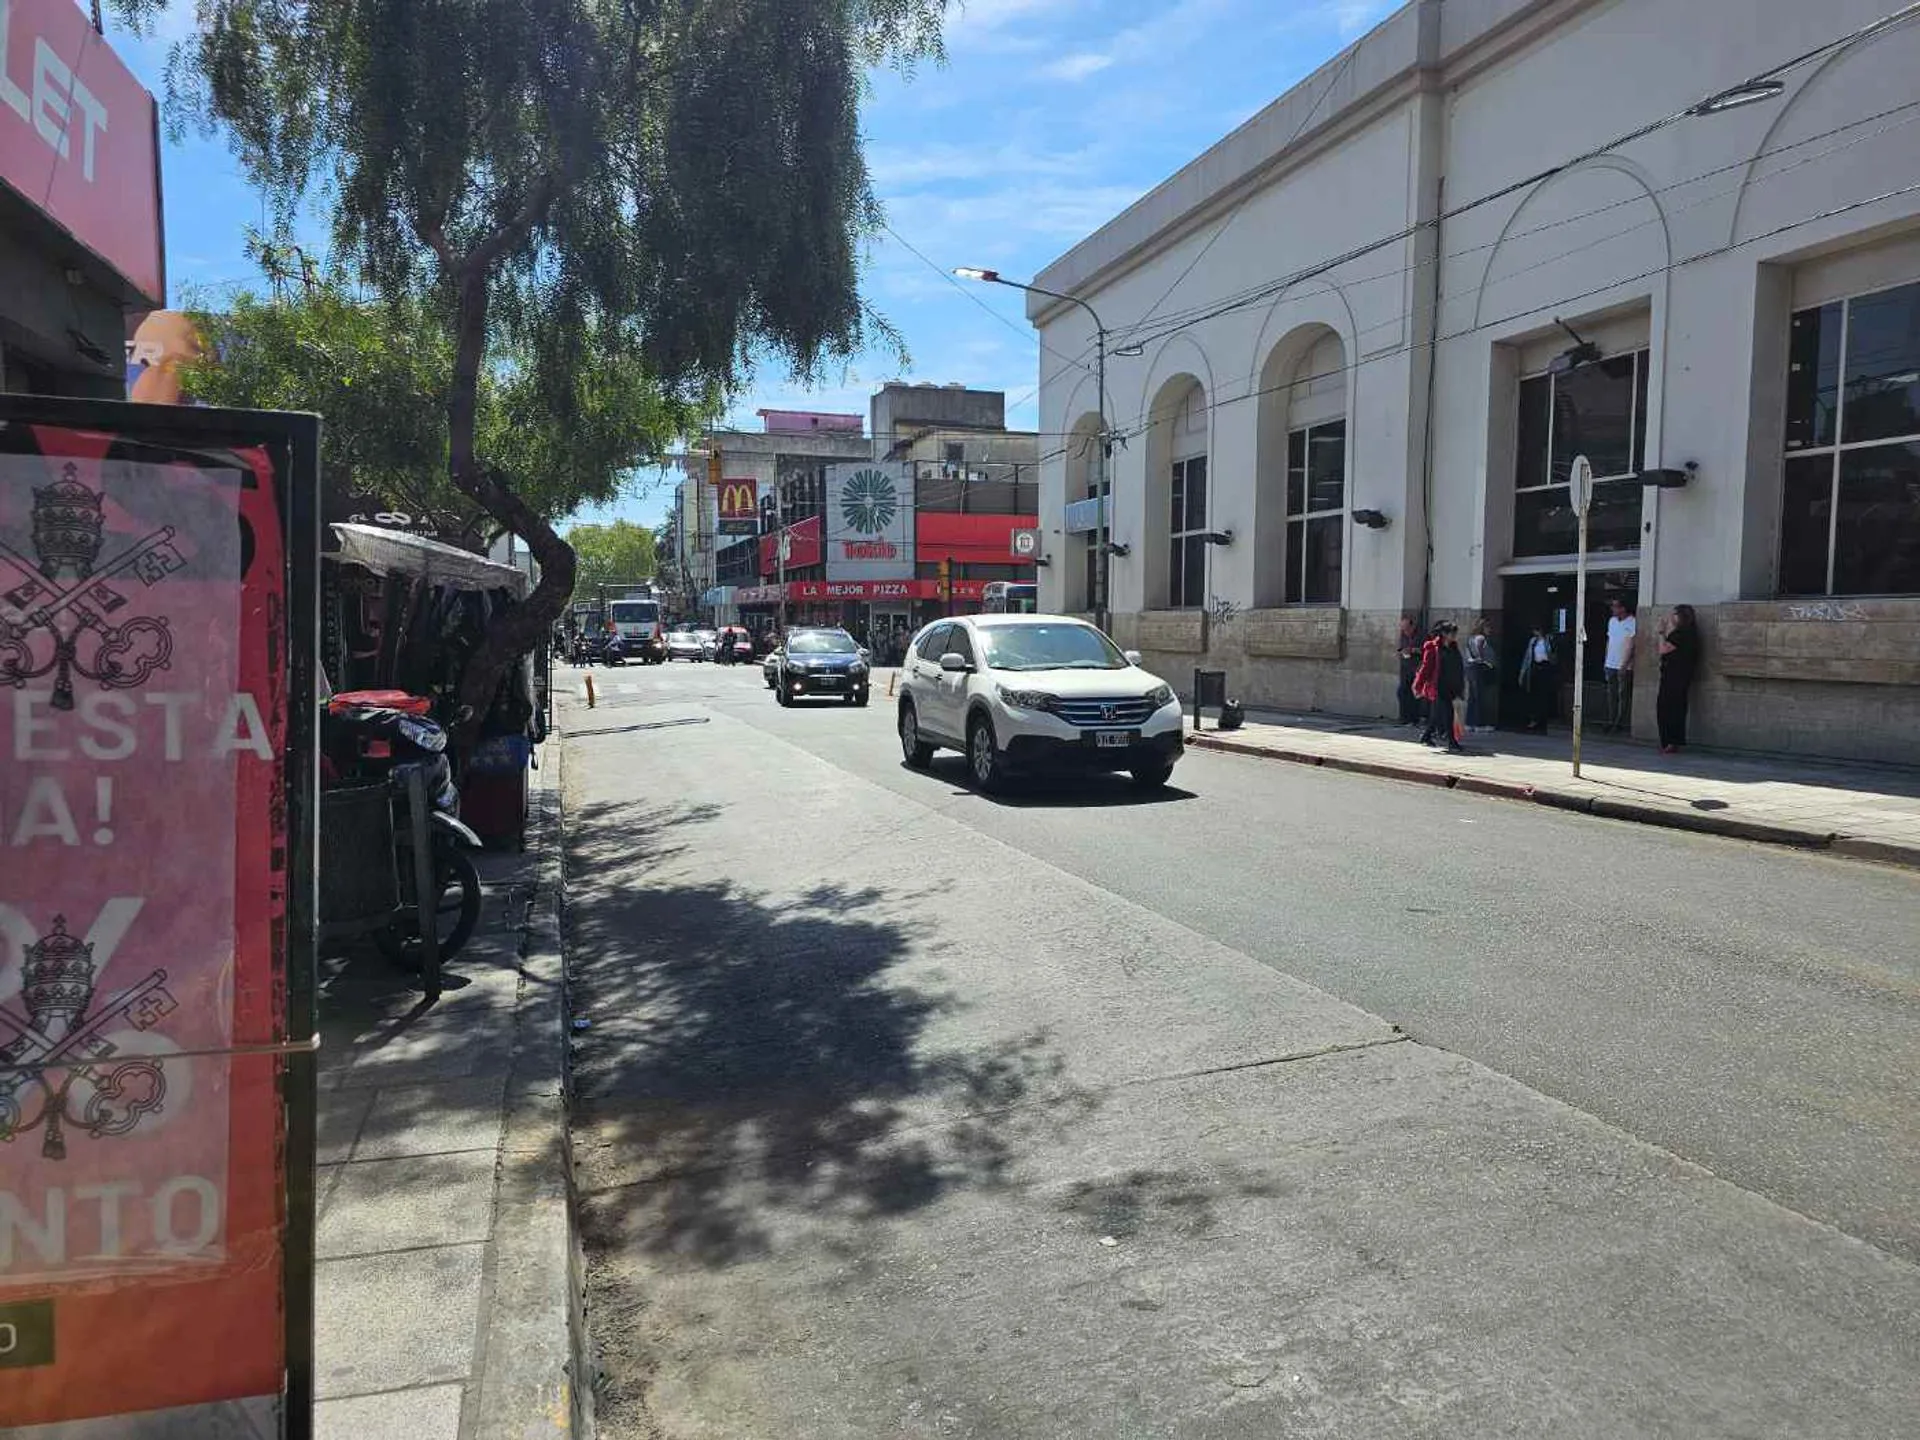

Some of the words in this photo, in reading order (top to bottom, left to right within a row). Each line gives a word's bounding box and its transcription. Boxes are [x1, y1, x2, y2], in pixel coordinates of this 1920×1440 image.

[803, 586, 817, 596] LA
[827, 585, 864, 596] MEJOR
[873, 584, 909, 595] PIZZA
[14, 690, 275, 761] ESTA
